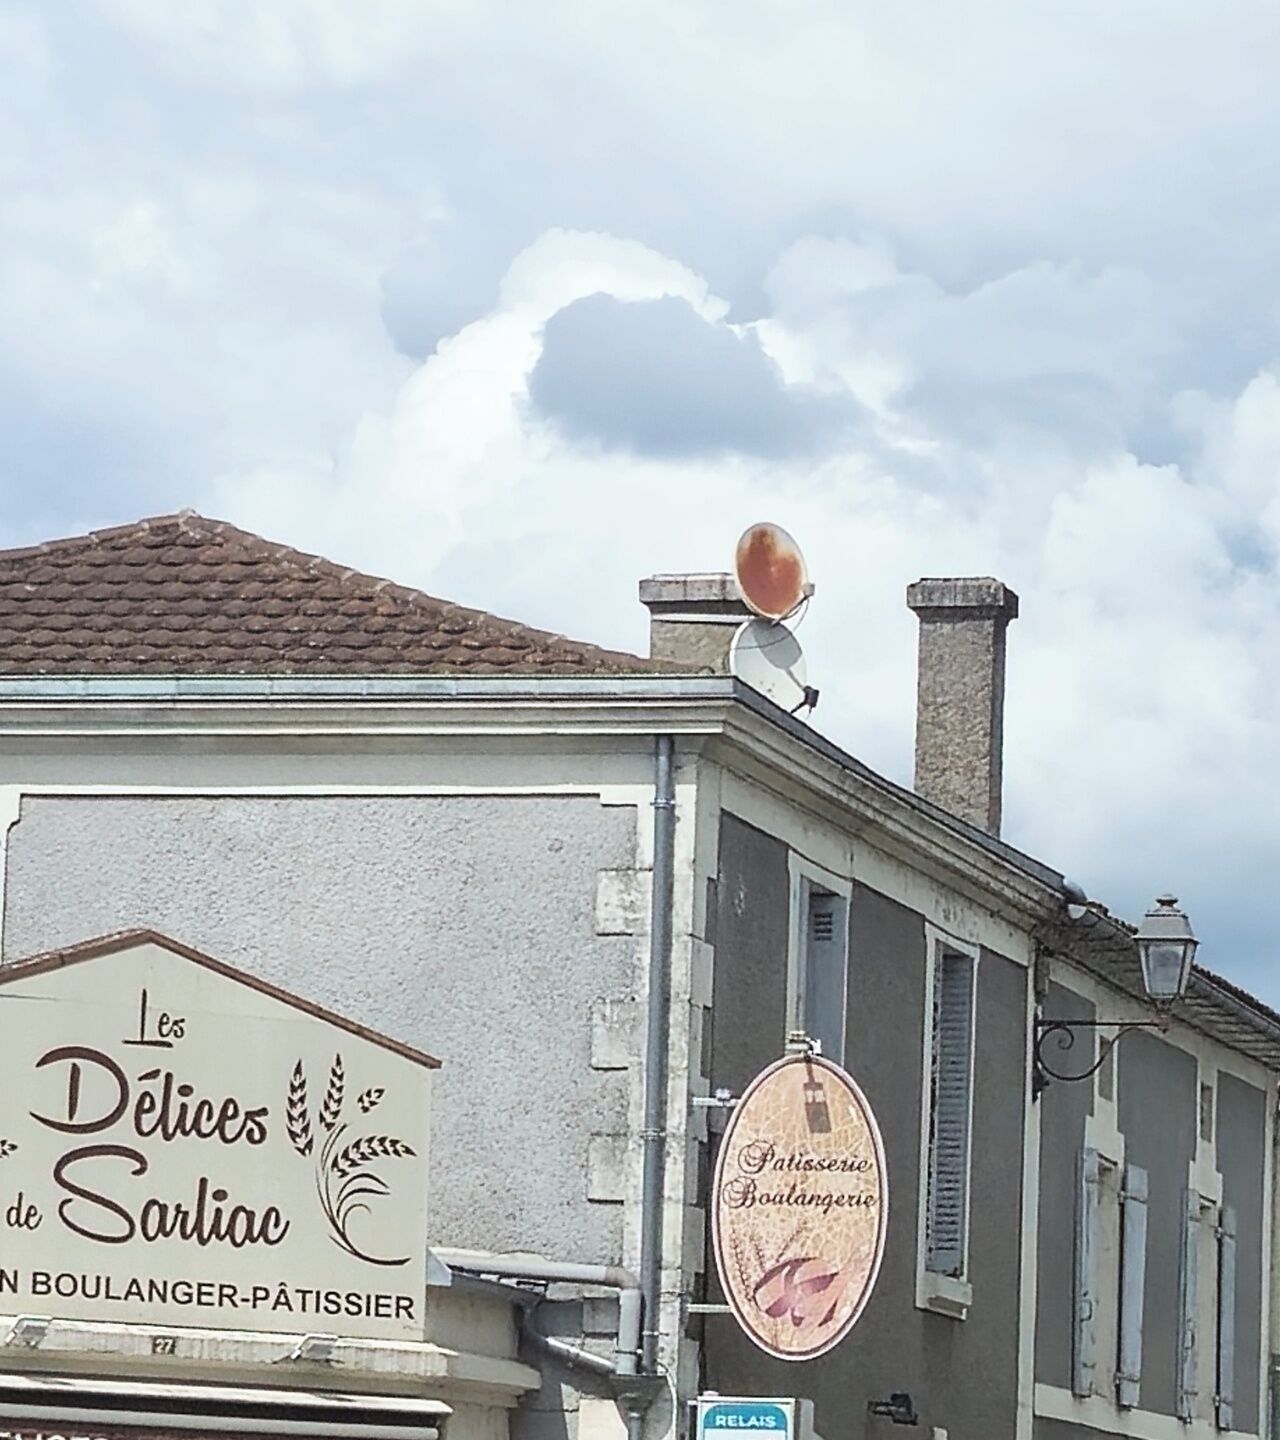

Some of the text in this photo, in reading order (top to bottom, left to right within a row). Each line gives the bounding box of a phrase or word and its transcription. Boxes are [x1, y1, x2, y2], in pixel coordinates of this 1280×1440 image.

[122, 988, 186, 1048] Les
[29, 1045, 269, 1145] Délices
[737, 1139, 874, 1175] Patisserie
[6, 1143, 291, 1248] de Sarliac
[722, 1175, 877, 1215] Boulangerie
[30, 1270, 417, 1320] BOULANGER-PÂTISSIER
[155, 1338, 174, 1354] 27
[714, 1414, 777, 1428] RELAIS
